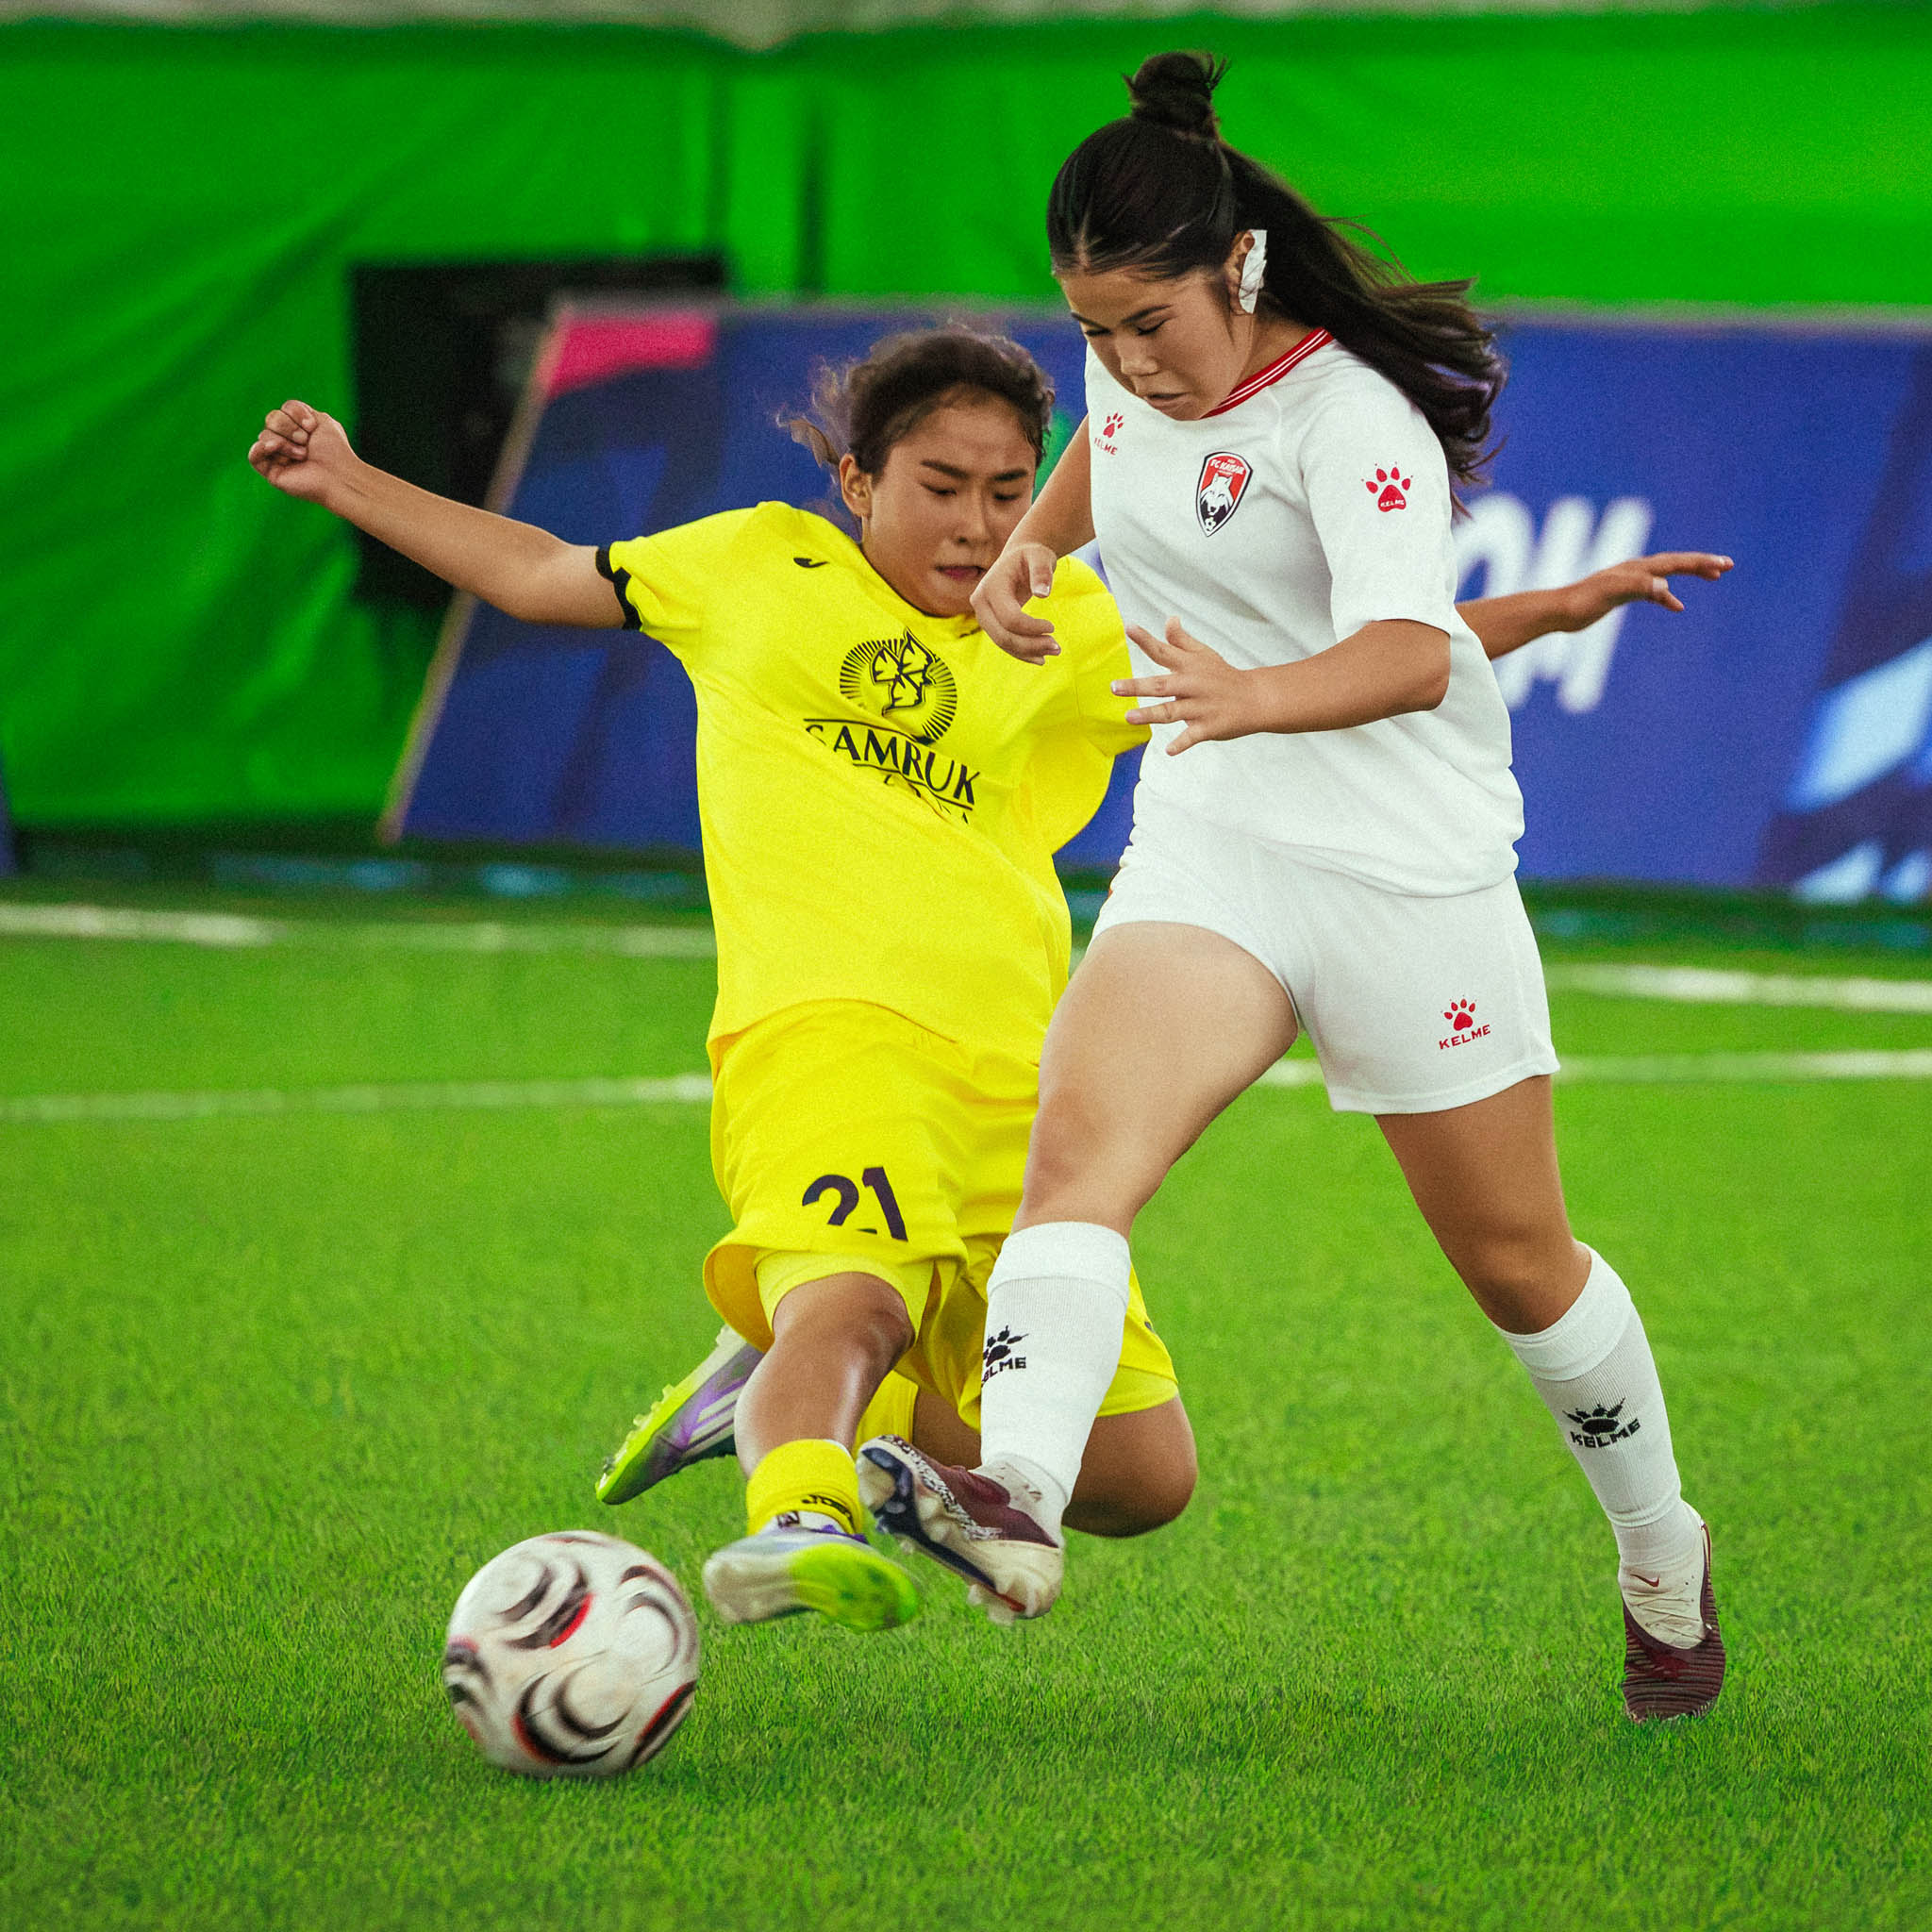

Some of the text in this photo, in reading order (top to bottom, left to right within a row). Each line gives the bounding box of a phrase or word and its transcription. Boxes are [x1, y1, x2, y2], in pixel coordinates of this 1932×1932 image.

[1439, 1024, 1491, 1050] KELME
[802, 1166, 908, 1242] 21
[981, 1357, 1026, 1388] ELME
[1570, 1418, 1641, 1449] KELME
